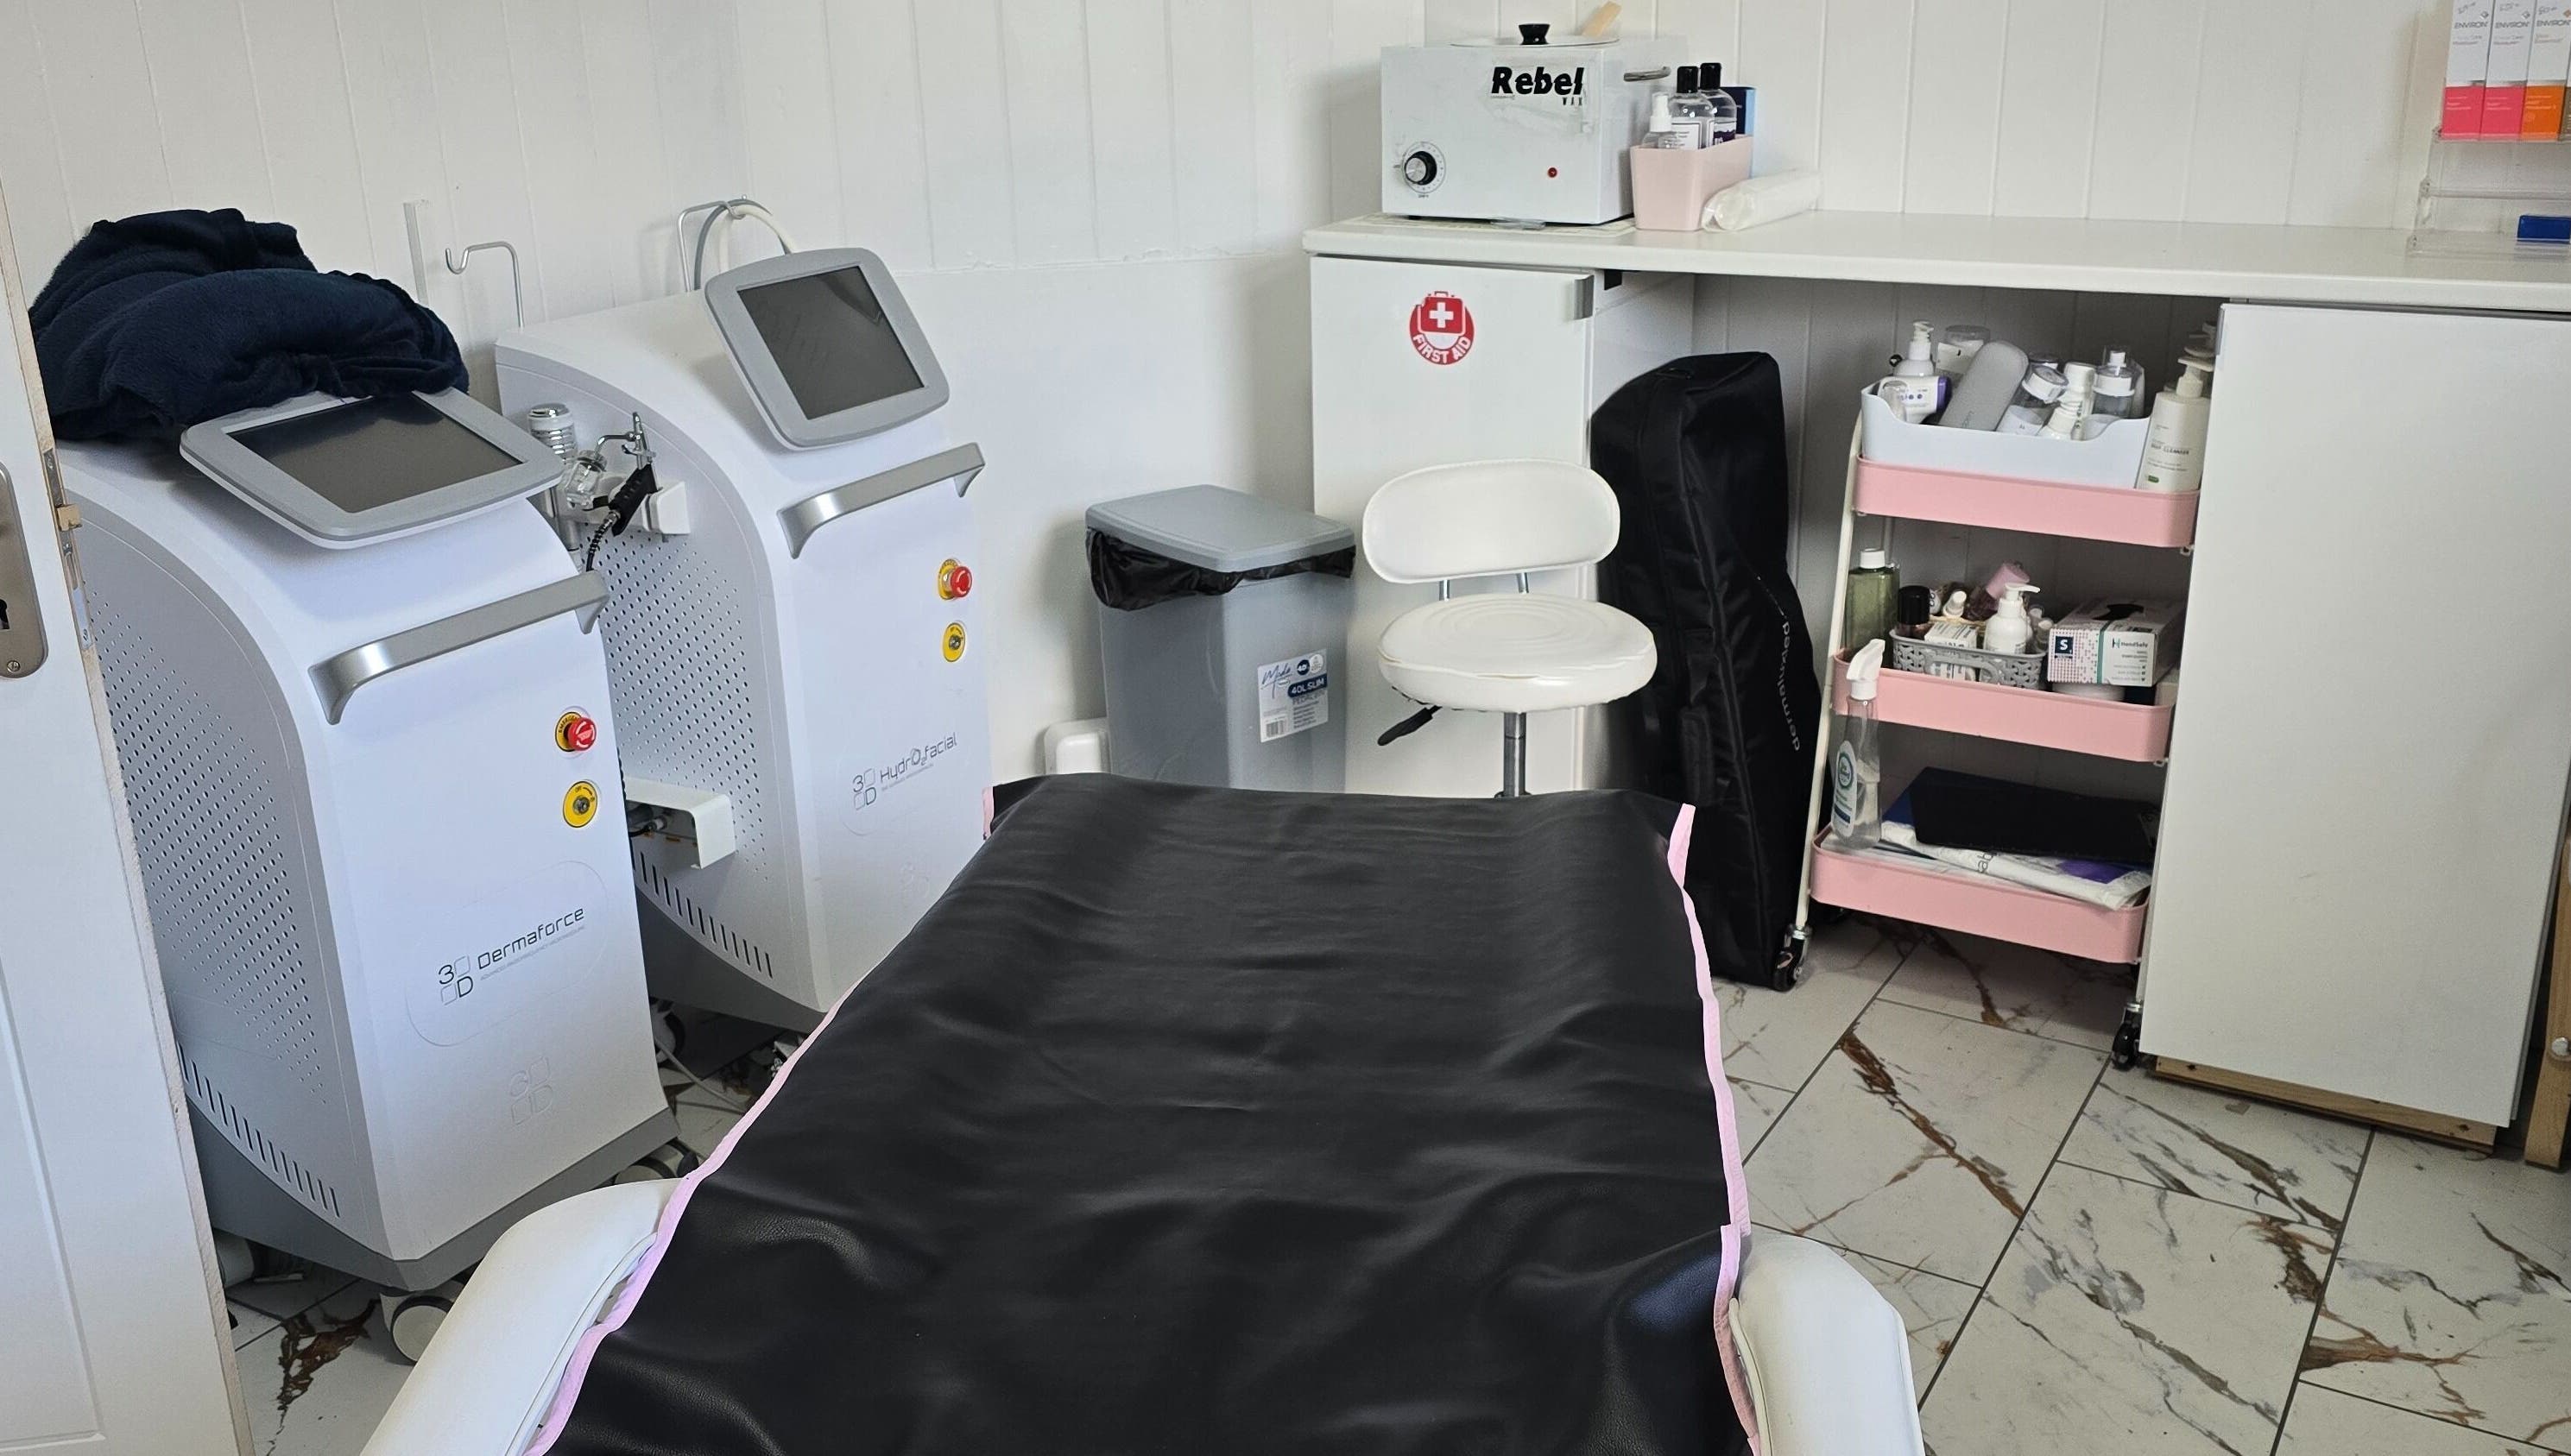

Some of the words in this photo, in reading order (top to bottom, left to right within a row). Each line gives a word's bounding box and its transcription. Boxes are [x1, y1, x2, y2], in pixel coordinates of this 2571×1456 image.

[1491, 66, 1585, 96] Rebel
[1412, 333, 1450, 363] FIRST
[1451, 337, 1471, 360] AID
[2059, 639, 2069, 651] S
[477, 908, 584, 970] Dermaforce
